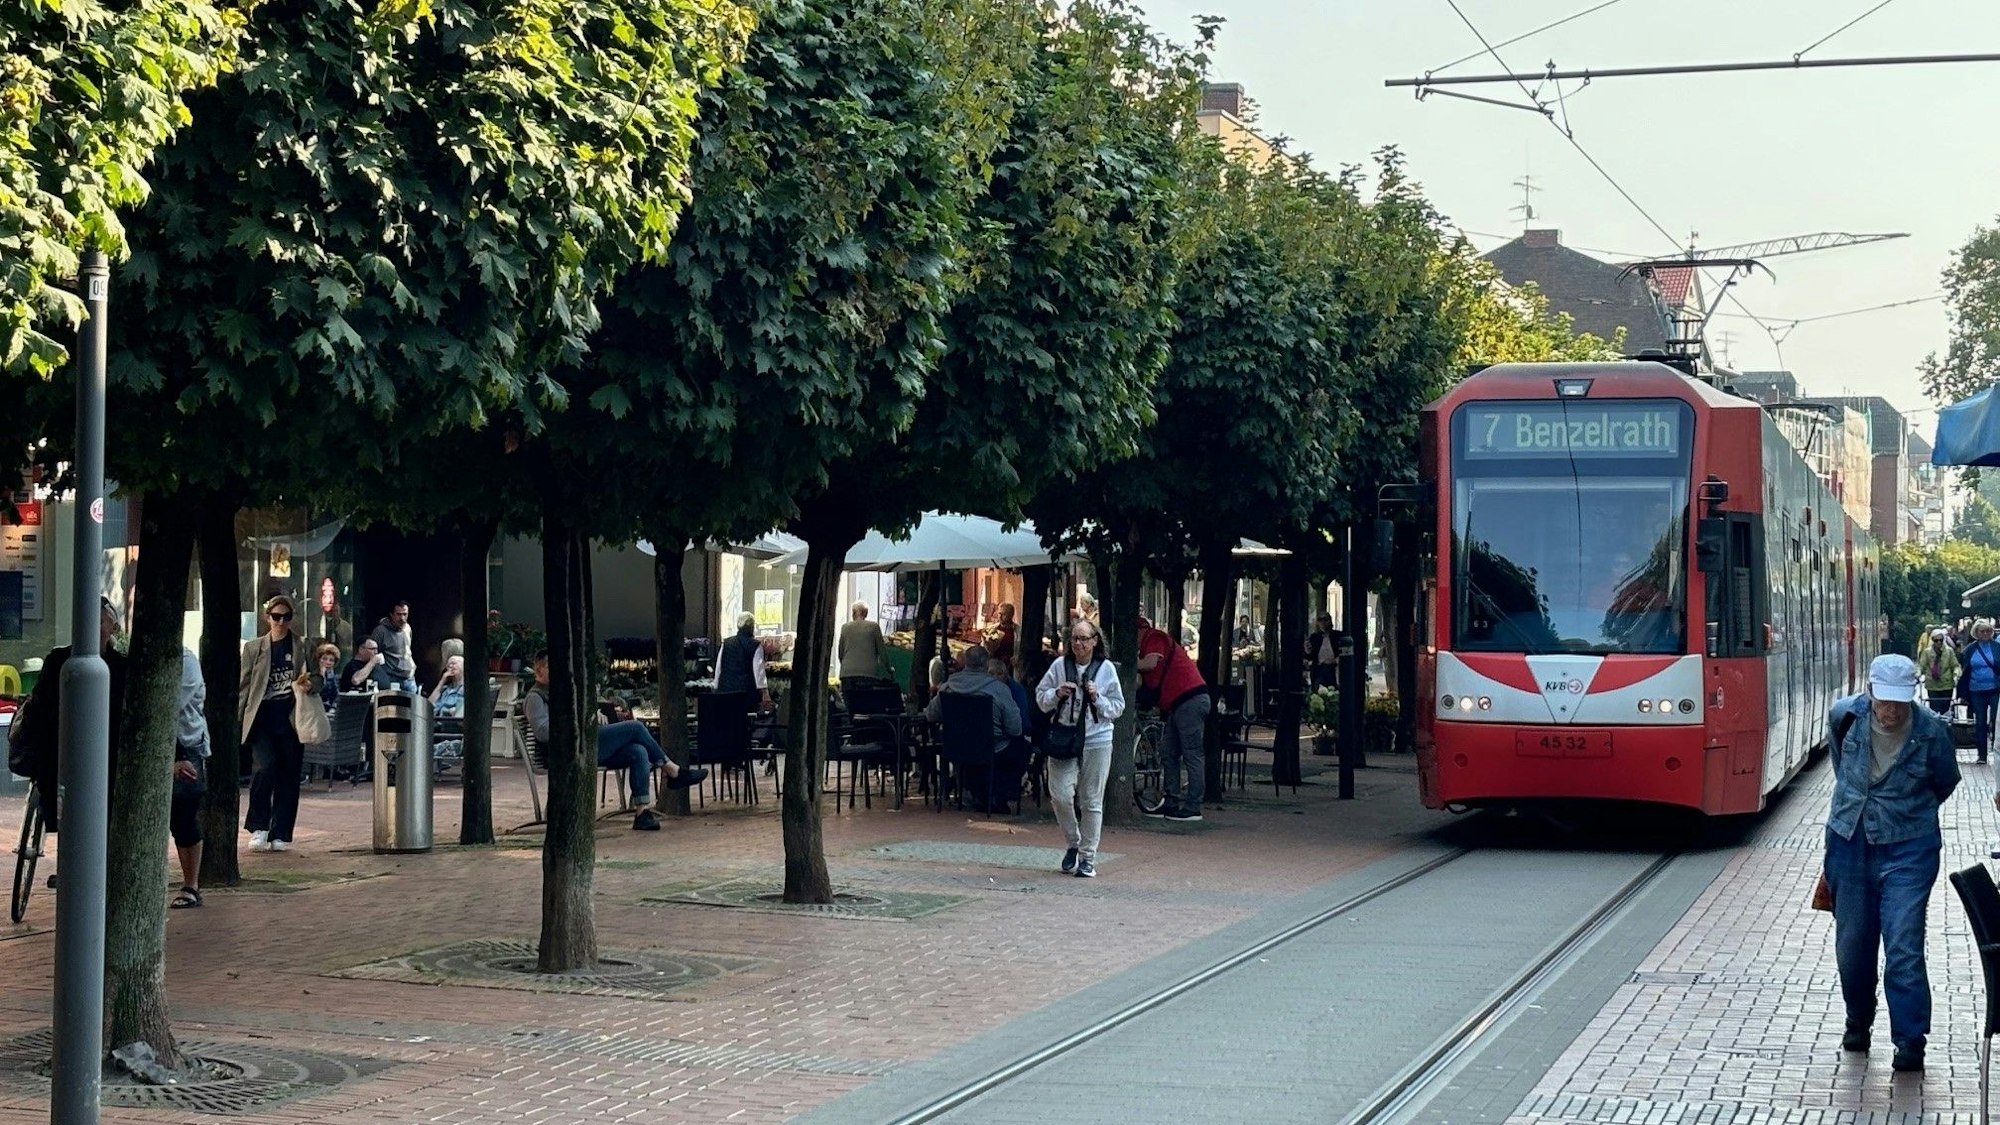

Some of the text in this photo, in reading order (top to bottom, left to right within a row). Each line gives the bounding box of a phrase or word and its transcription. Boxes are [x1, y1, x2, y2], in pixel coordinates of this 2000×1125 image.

[1484, 412, 1670, 447] 7 Benzelrath
[1545, 681, 1567, 691] KVB
[1540, 736, 1587, 750] 4532
